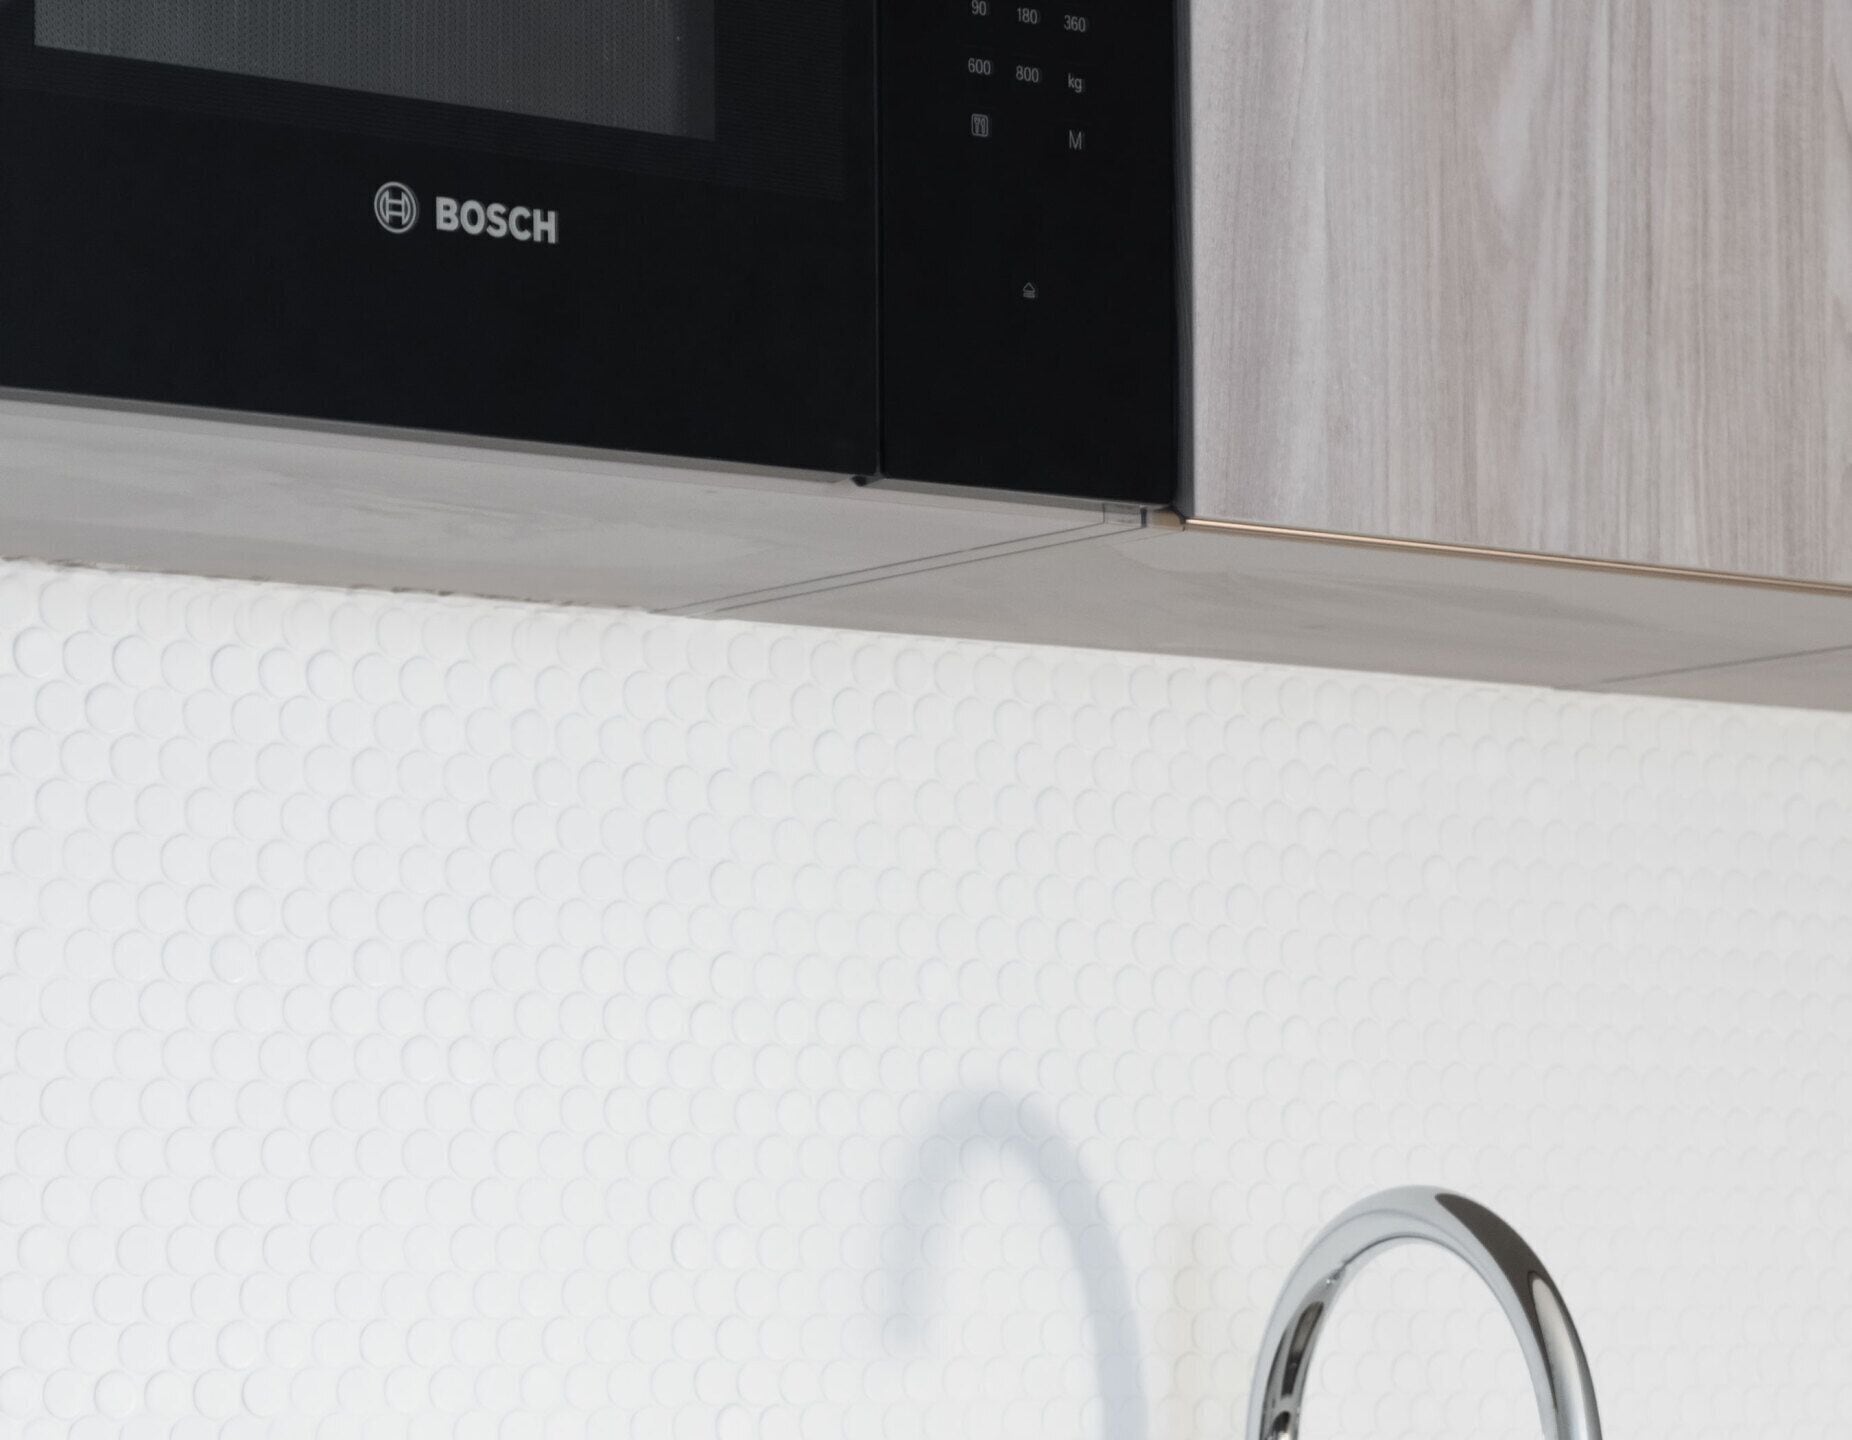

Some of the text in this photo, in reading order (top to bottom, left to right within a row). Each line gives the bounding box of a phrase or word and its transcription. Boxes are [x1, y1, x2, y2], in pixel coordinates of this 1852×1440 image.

[971, 0, 1086, 33] 90 180 360
[967, 57, 1083, 93] 600 800 kg
[1068, 130, 1083, 150] M
[435, 196, 557, 244] BOSCH
